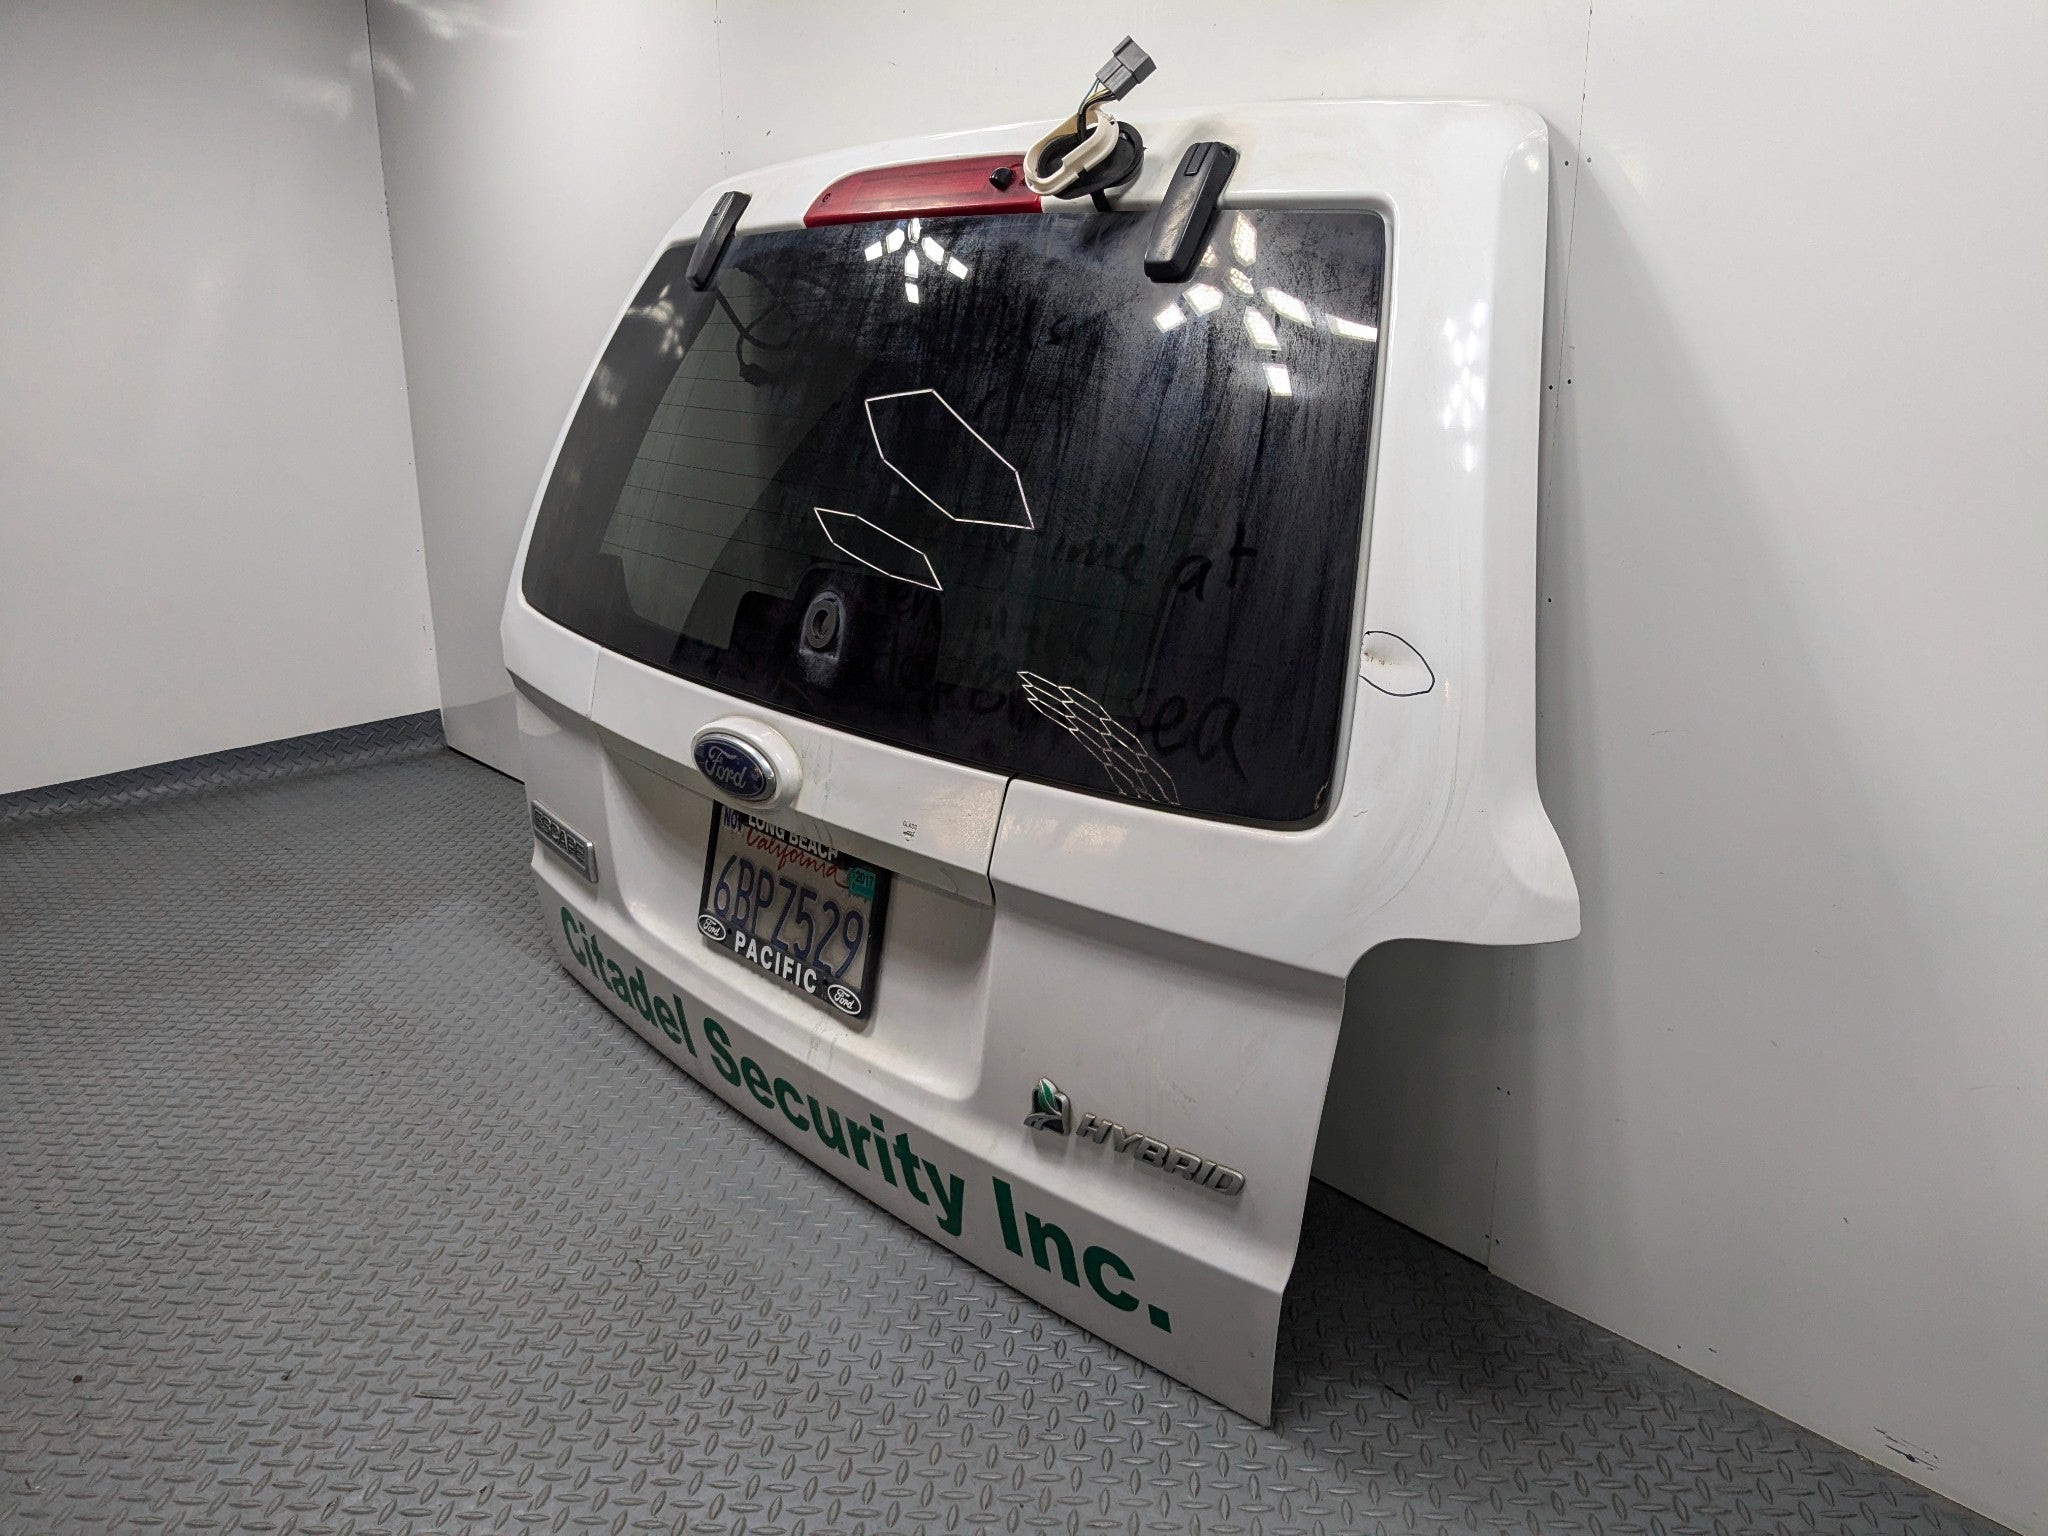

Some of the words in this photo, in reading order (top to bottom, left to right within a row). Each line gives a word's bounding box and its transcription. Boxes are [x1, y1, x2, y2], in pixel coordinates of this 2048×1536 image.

[704, 745, 748, 789] Ford
[746, 825, 849, 889] California
[748, 814, 786, 840] LONG
[788, 832, 839, 861] BEACH
[854, 869, 874, 889] 2017
[702, 917, 721, 938] Ford
[713, 854, 864, 979] 6BPZ529
[734, 929, 818, 995] PACIFIC
[833, 988, 855, 1011] Ford
[560, 905, 698, 1058] Citadel
[702, 1017, 966, 1238] Security
[992, 1173, 1173, 1335] Inc.
[1075, 1112, 1246, 1196] HYBRID
